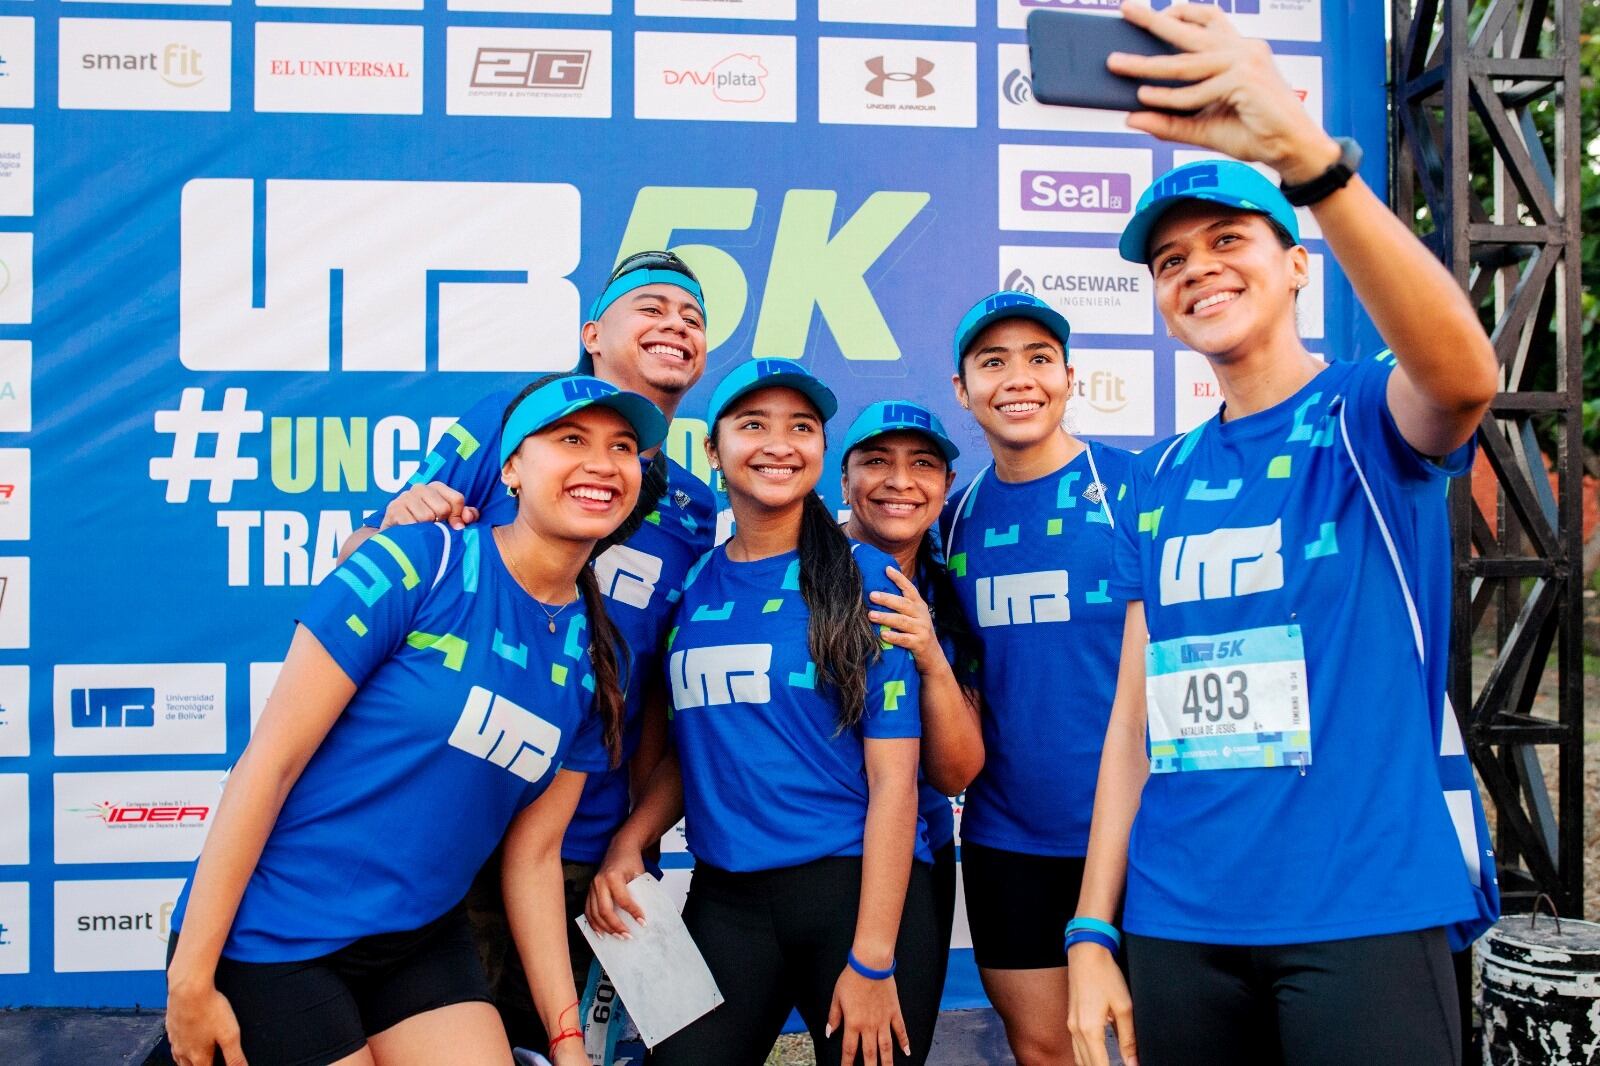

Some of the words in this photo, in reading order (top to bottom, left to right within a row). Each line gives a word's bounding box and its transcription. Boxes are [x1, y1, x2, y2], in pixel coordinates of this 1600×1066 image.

[82, 52, 157, 70] smart
[162, 43, 204, 77] fit
[271, 60, 295, 76] EL
[300, 61, 410, 78] UNIVERSAL
[471, 49, 591, 88] 2G
[1031, 174, 1110, 209] Seal
[610, 185, 931, 361] 5K
[1042, 274, 1139, 293] CASEWARE
[1090, 371, 1126, 401] fit
[1193, 383, 1215, 397] EL
[1217, 638, 1246, 659] 5K
[166, 694, 215, 702] Universidad
[166, 703, 214, 712] Tecnológica
[1182, 670, 1250, 724] 493
[1180, 725, 1204, 737] NATALIA
[1205, 724, 1214, 735] DE
[77, 913, 153, 931] smart
[593, 968, 616, 1024] 09
